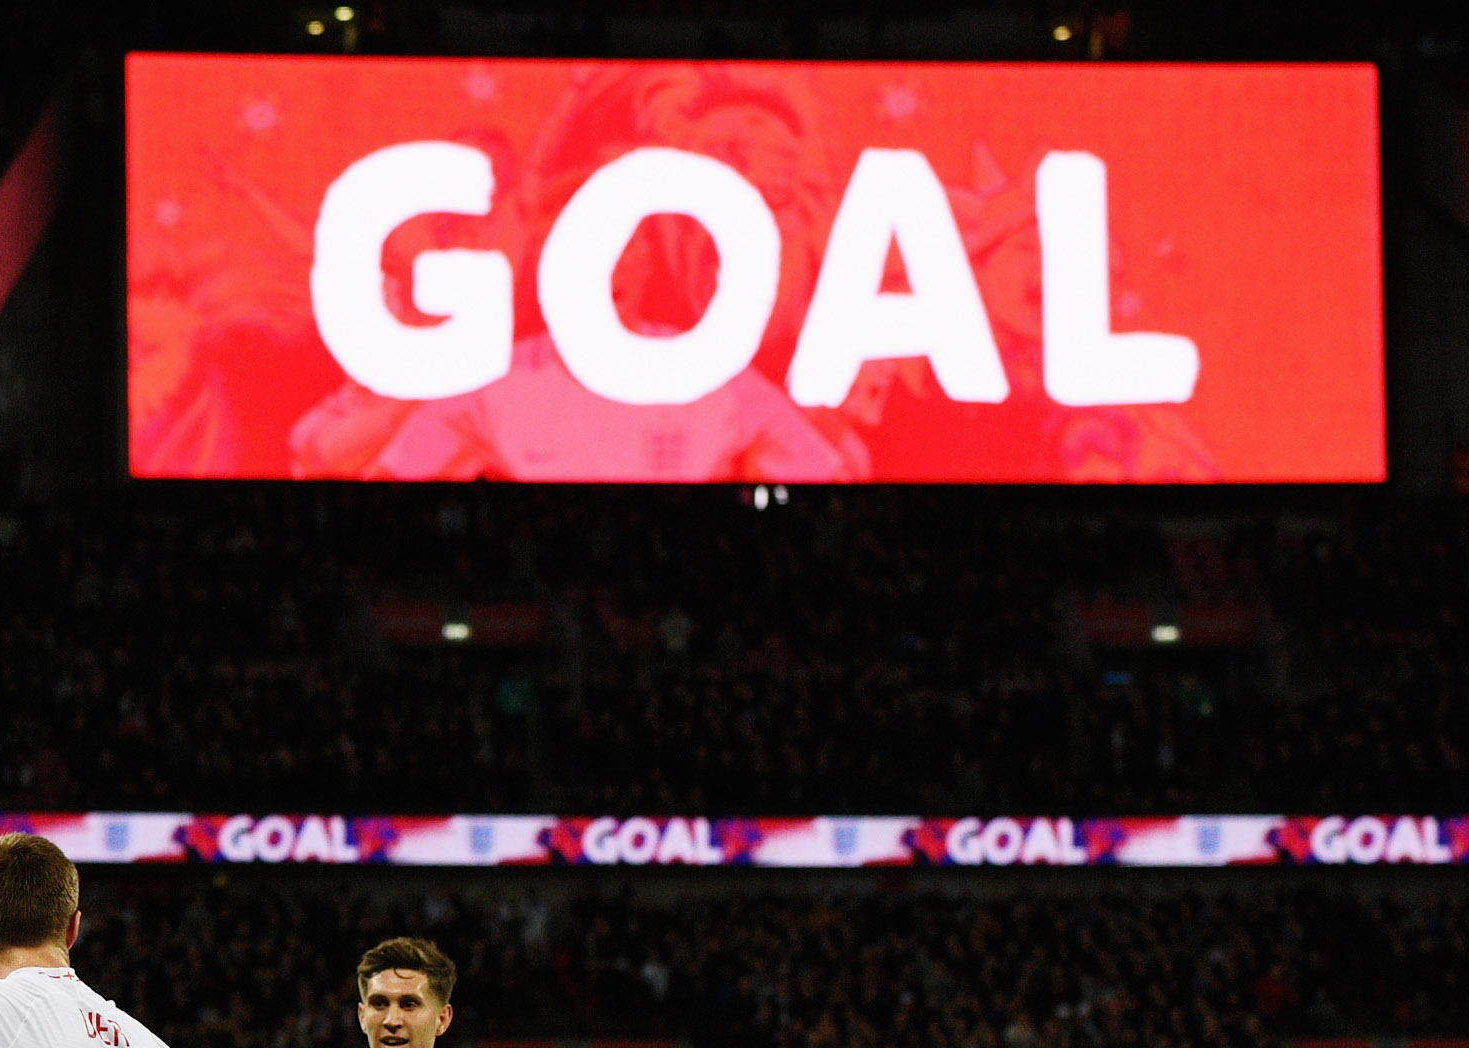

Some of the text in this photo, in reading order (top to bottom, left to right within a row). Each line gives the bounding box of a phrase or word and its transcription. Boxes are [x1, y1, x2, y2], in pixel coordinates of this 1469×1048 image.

[309, 140, 1200, 408] GOAL
[218, 815, 359, 862] GOAL
[582, 817, 723, 865] GOAL
[946, 818, 1087, 865] GOAL
[1310, 817, 1452, 864] GOAL
